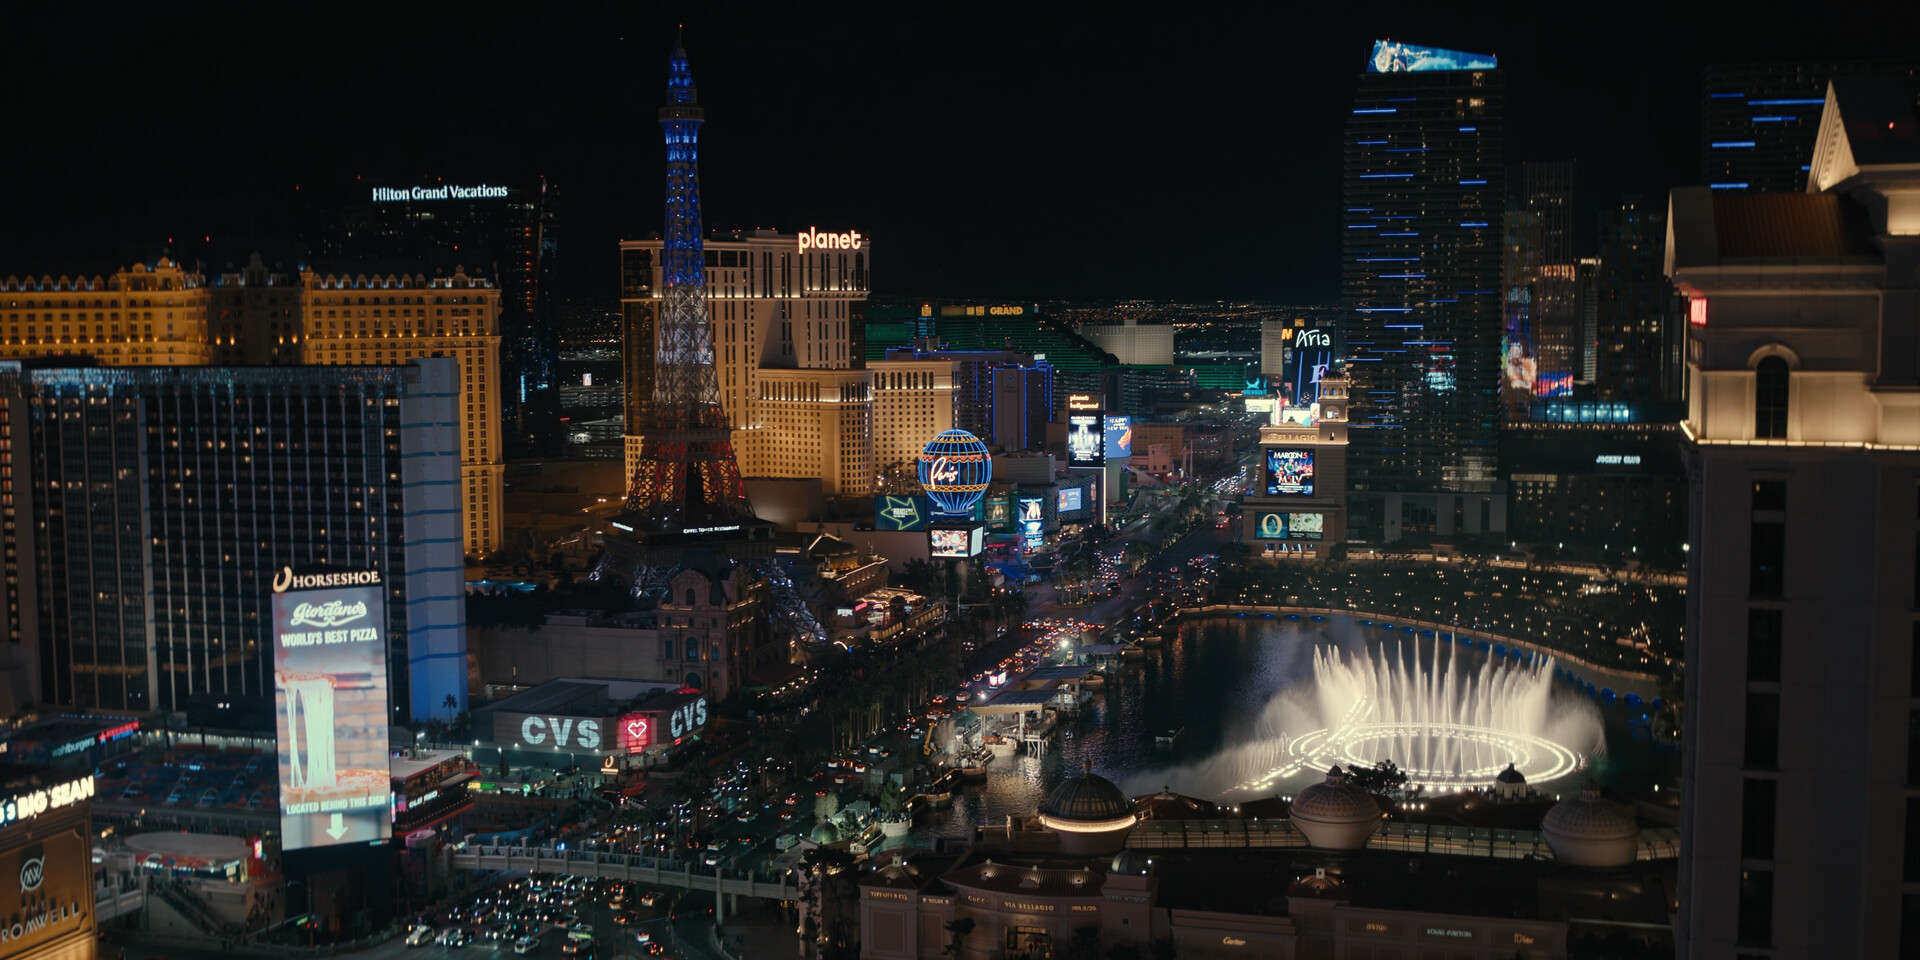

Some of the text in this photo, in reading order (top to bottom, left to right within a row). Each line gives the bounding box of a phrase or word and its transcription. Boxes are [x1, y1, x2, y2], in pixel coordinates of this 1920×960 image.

[372, 184, 508, 202] Hilton Grand Vacations
[798, 226, 862, 254] planet
[989, 306, 1024, 315] GRAND
[1295, 329, 1331, 348] Aria
[1069, 394, 1090, 402] planet
[1069, 402, 1099, 410] hollywood
[1268, 432, 1318, 442] BELLAGIO
[1273, 451, 1303, 459] MAROON
[1595, 454, 1641, 465] JOCKEY CLUB
[930, 456, 959, 490] Paris
[1261, 513, 1283, 535] O
[292, 571, 379, 589] HORSESHOE
[290, 600, 368, 627] Giordano's
[281, 627, 378, 648] WORLD'S BEST PIZZA
[670, 697, 707, 739] CVS
[521, 716, 601, 749] CVS
[17, 790, 48, 821] BIG
[50, 774, 95, 809] SEAN
[286, 795, 386, 815] LOCATED BEHIND THIS SIGN
[1018, 903, 1054, 911] BELLAGIO
